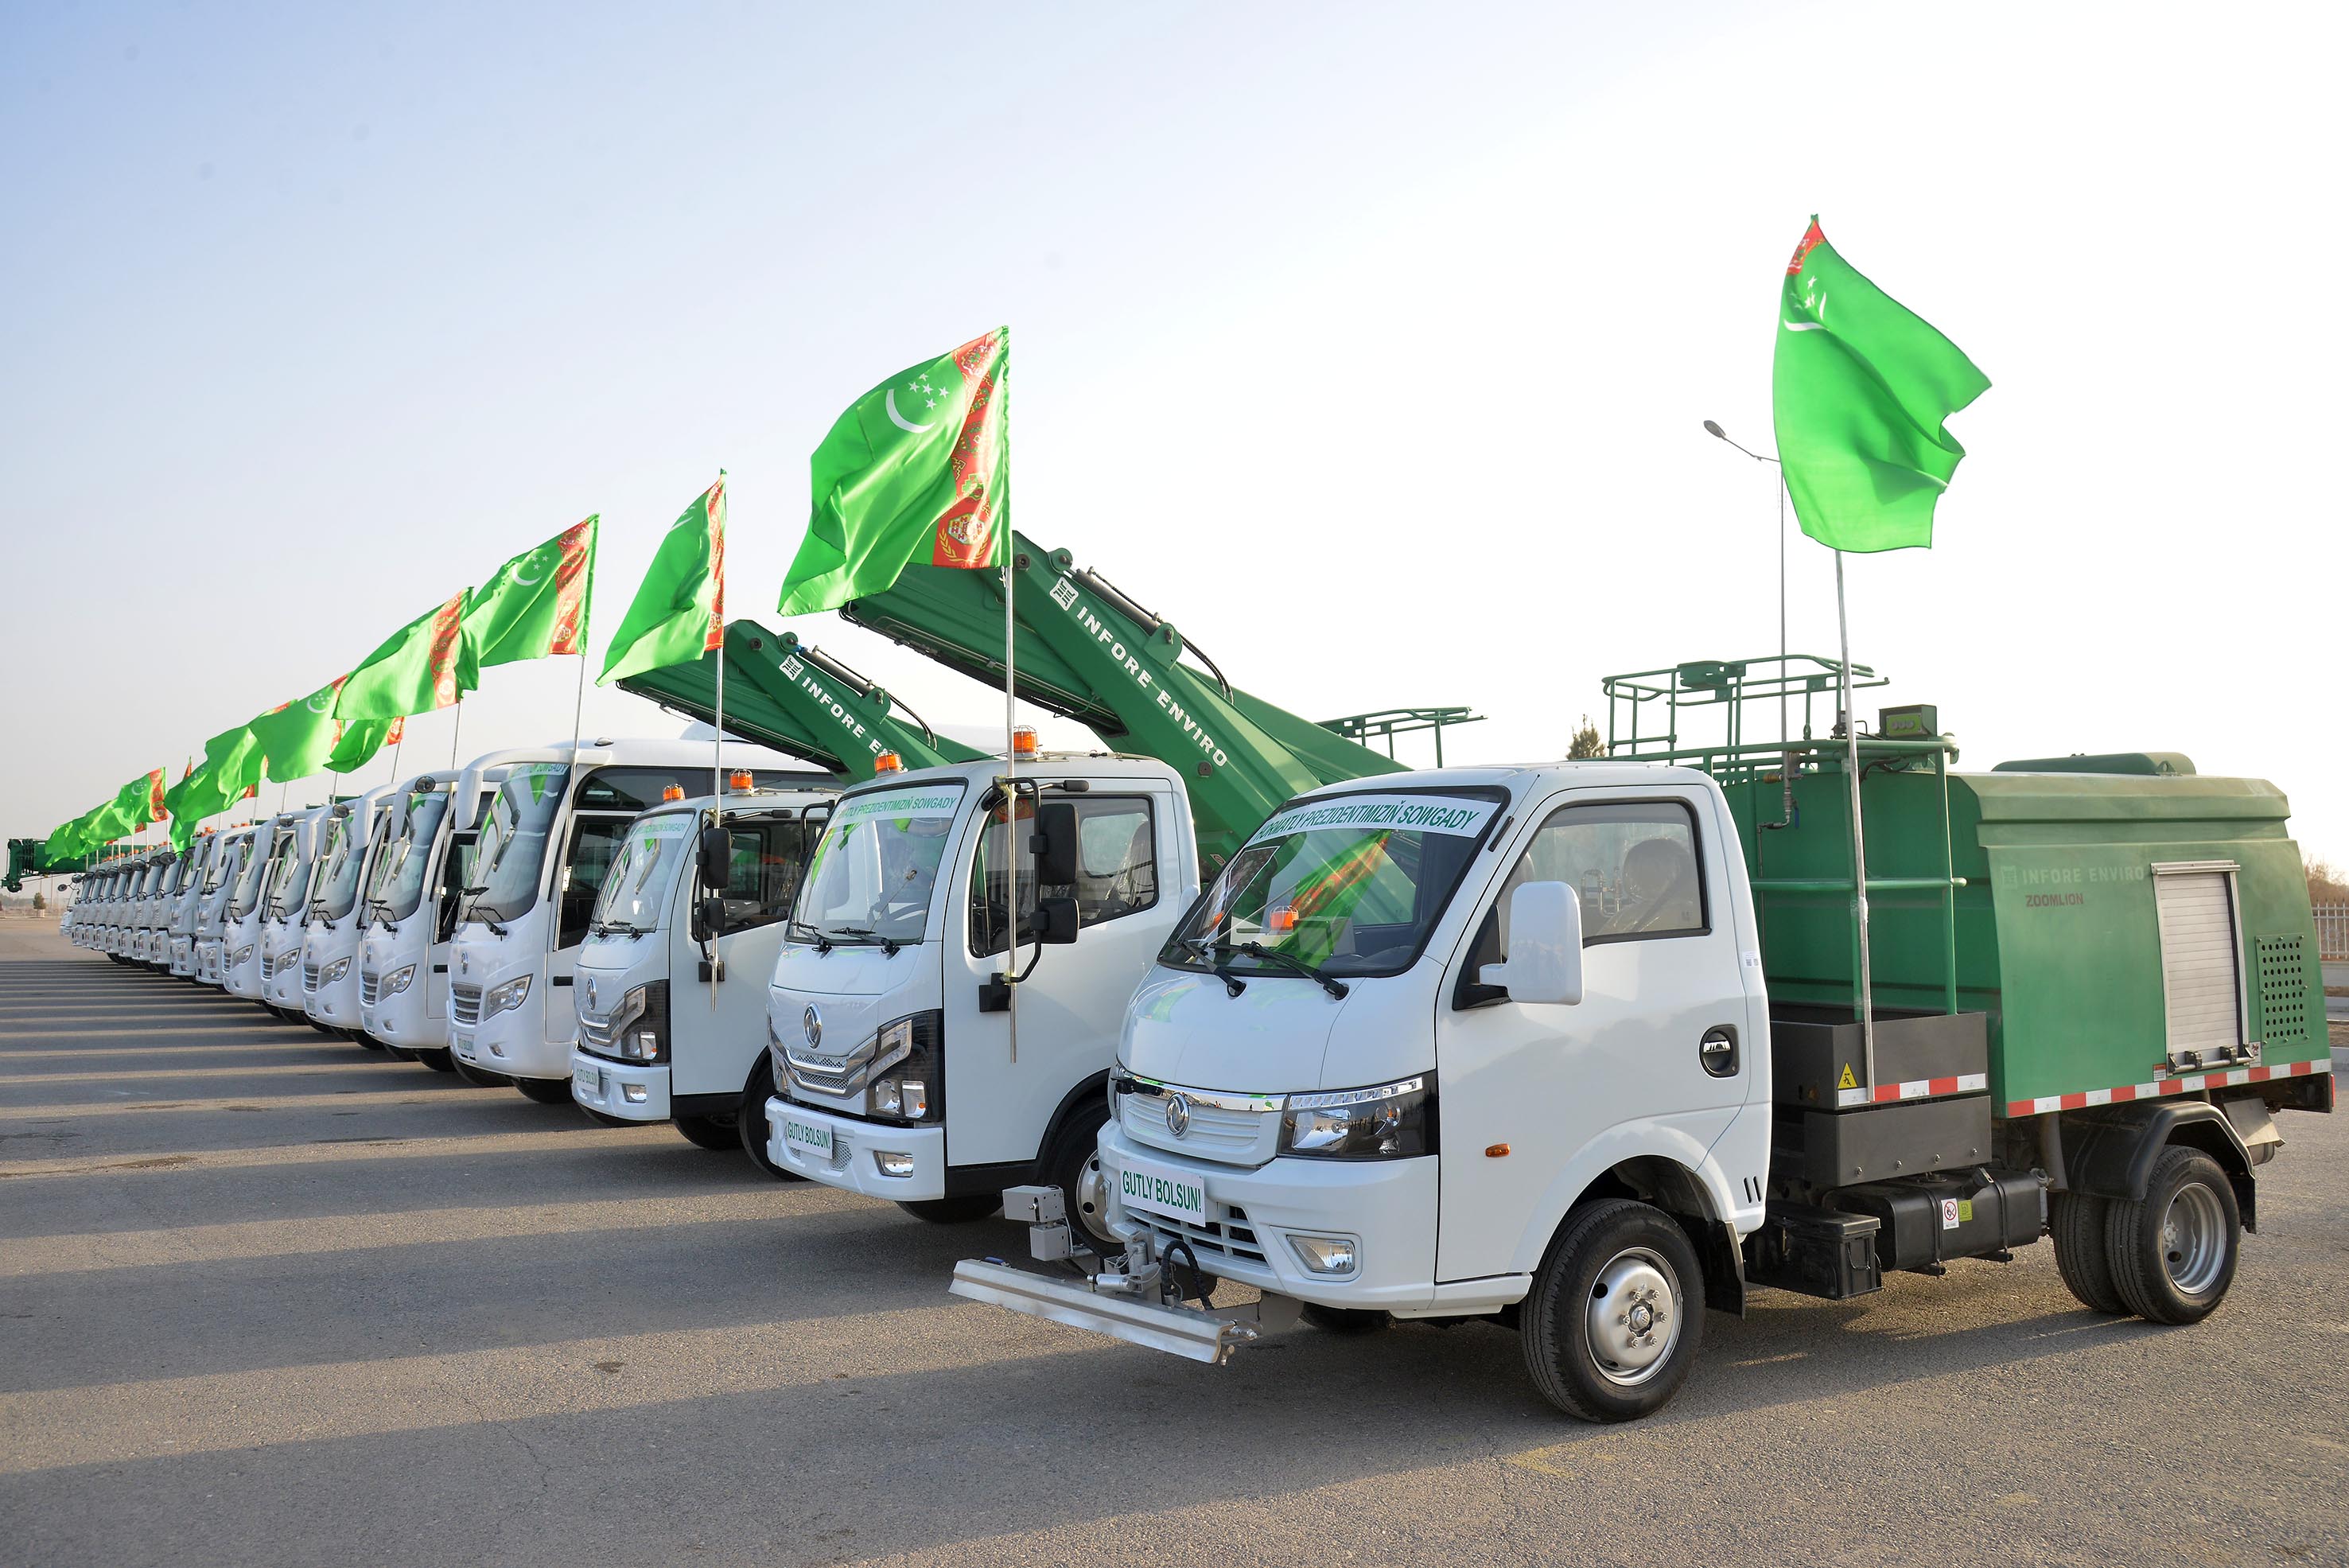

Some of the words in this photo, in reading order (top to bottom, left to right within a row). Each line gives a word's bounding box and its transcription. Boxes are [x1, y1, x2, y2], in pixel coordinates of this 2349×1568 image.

[1076, 605, 1153, 688] INFORE
[1156, 689, 1228, 768] ENVIRO
[801, 676, 866, 739] INFORE
[912, 797, 958, 809] SOWGADY
[1302, 800, 1406, 827] PREZIDENTIMIZIŇ
[1397, 805, 1480, 830] SOWGADY
[2022, 868, 2082, 885] INFORE
[2089, 866, 2145, 883] ENVIRO
[2025, 893, 2084, 908] ZOOMLION
[788, 1121, 805, 1142] GUTLY
[805, 1126, 830, 1150] BOLSUN!
[1122, 1170, 1153, 1200] GUTLY
[1155, 1178, 1202, 1213] BOLSUN!
